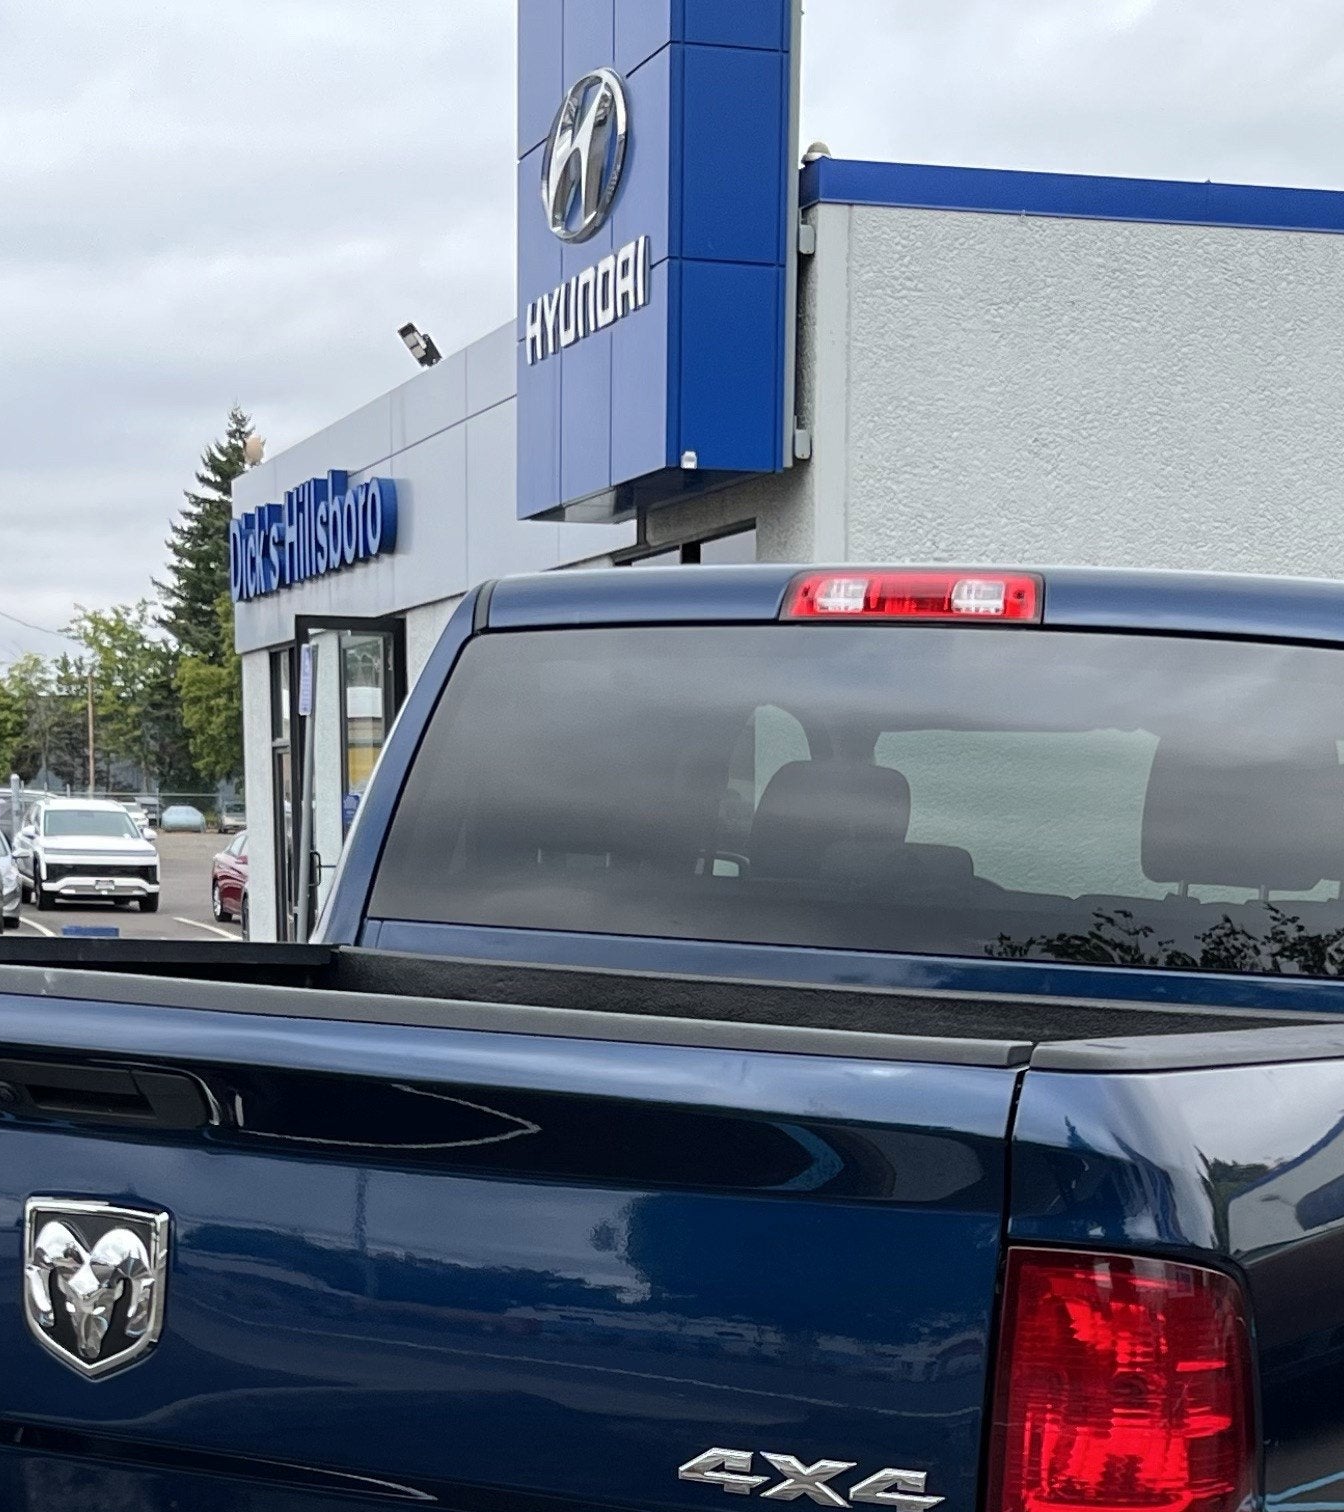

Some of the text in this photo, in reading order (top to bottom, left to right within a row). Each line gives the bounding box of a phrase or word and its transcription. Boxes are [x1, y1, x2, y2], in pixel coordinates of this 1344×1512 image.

[526, 235, 649, 365] HYUNDAI
[230, 470, 385, 600] Dick's Hillsboro
